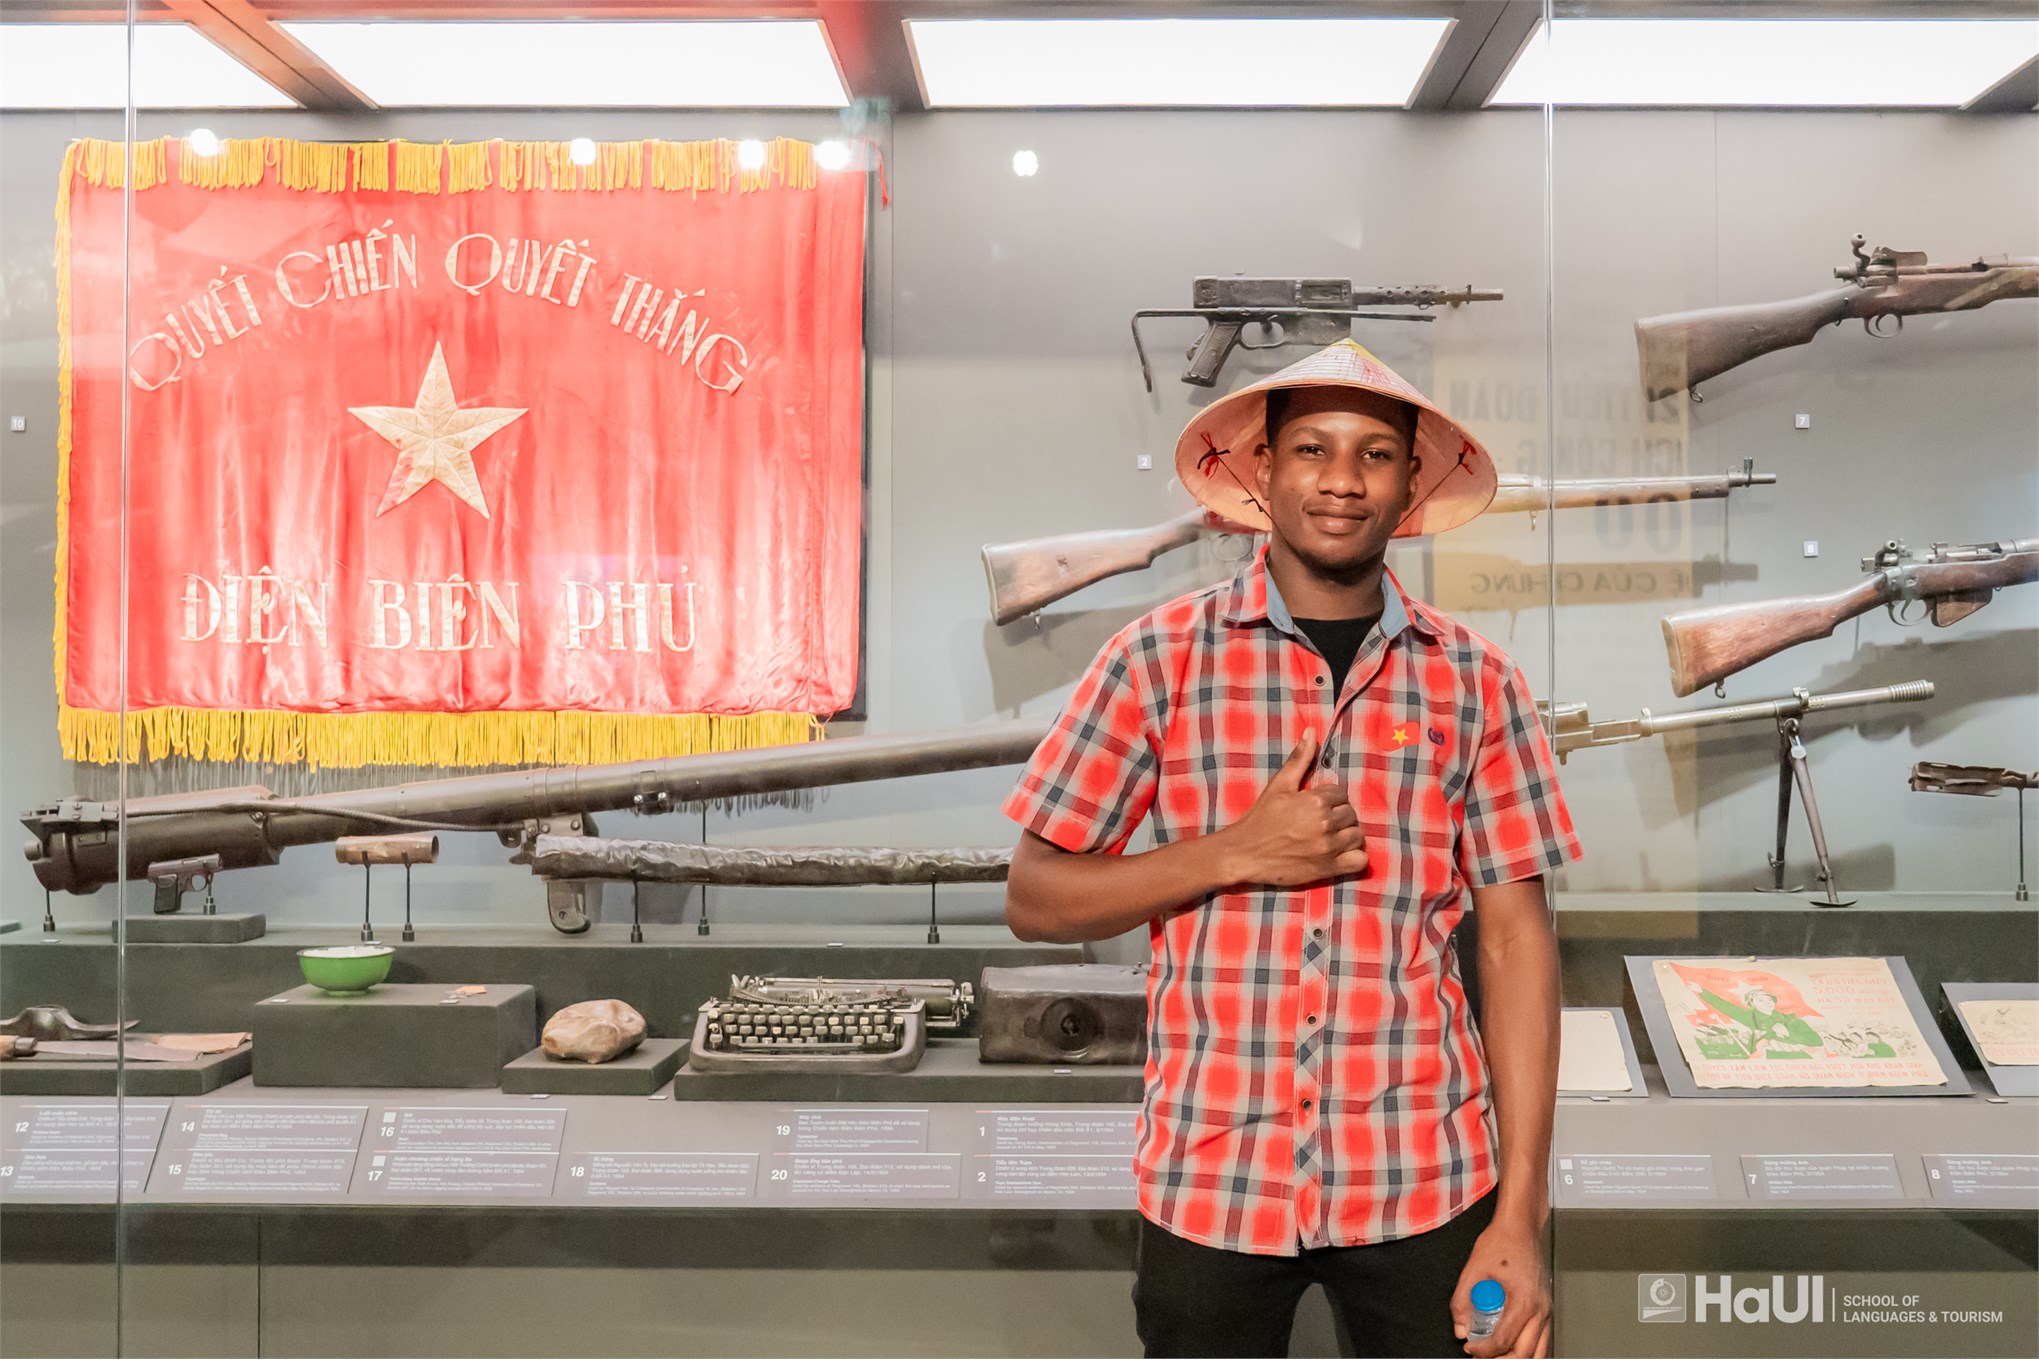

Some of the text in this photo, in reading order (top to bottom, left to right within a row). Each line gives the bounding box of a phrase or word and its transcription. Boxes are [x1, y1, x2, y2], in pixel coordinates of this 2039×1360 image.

[129, 219, 749, 396] QUYẾT CHIẾN QUYẾT THẮNG
[180, 564, 698, 655] ĐIỆN BIÊN PHỦ
[15, 1121, 29, 1133] 12
[181, 1121, 195, 1132] 14
[380, 1126, 394, 1137] 16
[776, 1125, 791, 1136] 19
[979, 1126, 986, 1137] 1
[0, 1166, 14, 1177] 13
[168, 1164, 182, 1175] 15
[570, 1166, 585, 1177] 18
[771, 1169, 788, 1180] 20
[1931, 1169, 1941, 1180] 8
[367, 1170, 383, 1181] 17
[977, 1171, 986, 1182] 2
[1564, 1174, 1574, 1185] 6
[1748, 1174, 1757, 1184] 7
